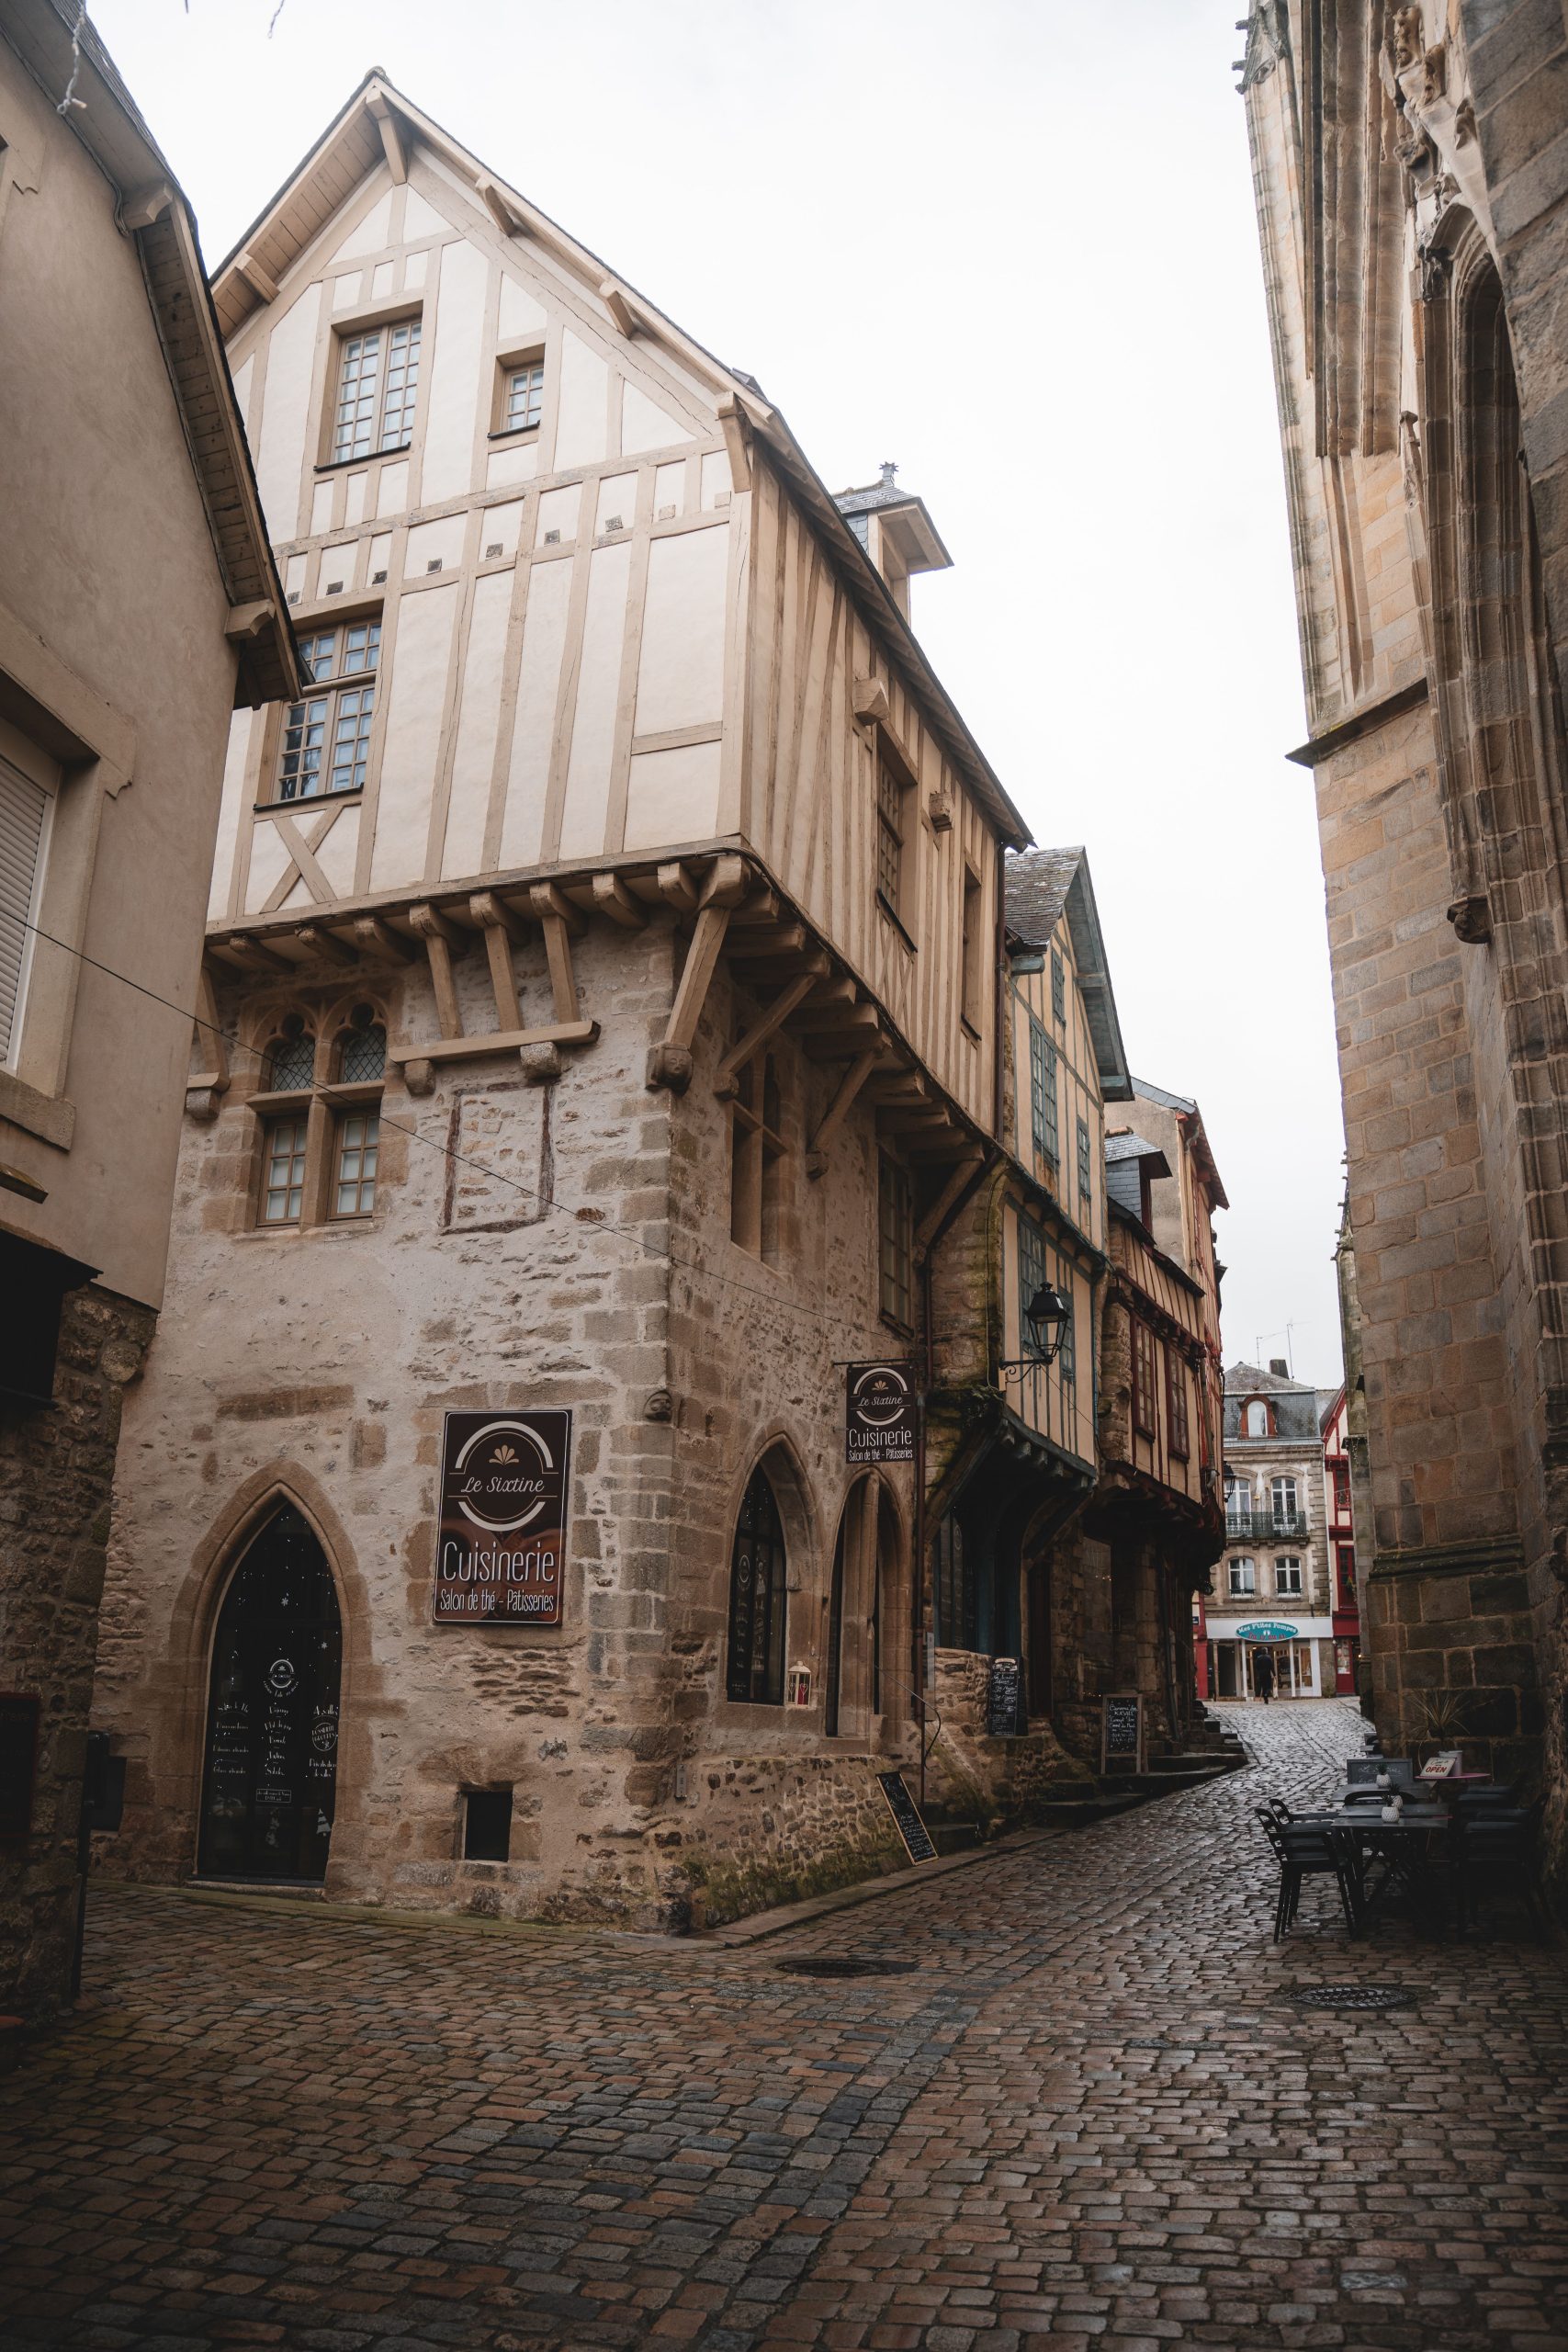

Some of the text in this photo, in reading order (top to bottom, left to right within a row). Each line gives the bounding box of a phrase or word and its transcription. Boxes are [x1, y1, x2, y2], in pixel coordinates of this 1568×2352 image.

[858, 1396, 903, 1407] Le Sixtine
[849, 1426, 912, 1448] Cuisinerie
[849, 1450, 863, 1462] Salon
[863, 1450, 871, 1461] de
[872, 1449, 881, 1460] thé
[886, 1447, 913, 1460] Pâtisseries
[460, 1476, 545, 1493] Le Sixtine
[443, 1541, 555, 1582] Cuisinerie
[440, 1588, 465, 1611] Salon
[468, 1588, 479, 1611] de
[480, 1589, 495, 1611] thé
[506, 1589, 555, 1611] Pâtisseries
[1238, 1625, 1251, 1634] Mes
[1273, 1623, 1297, 1634] Pompes
[1425, 1766, 1448, 1774] OPEN
